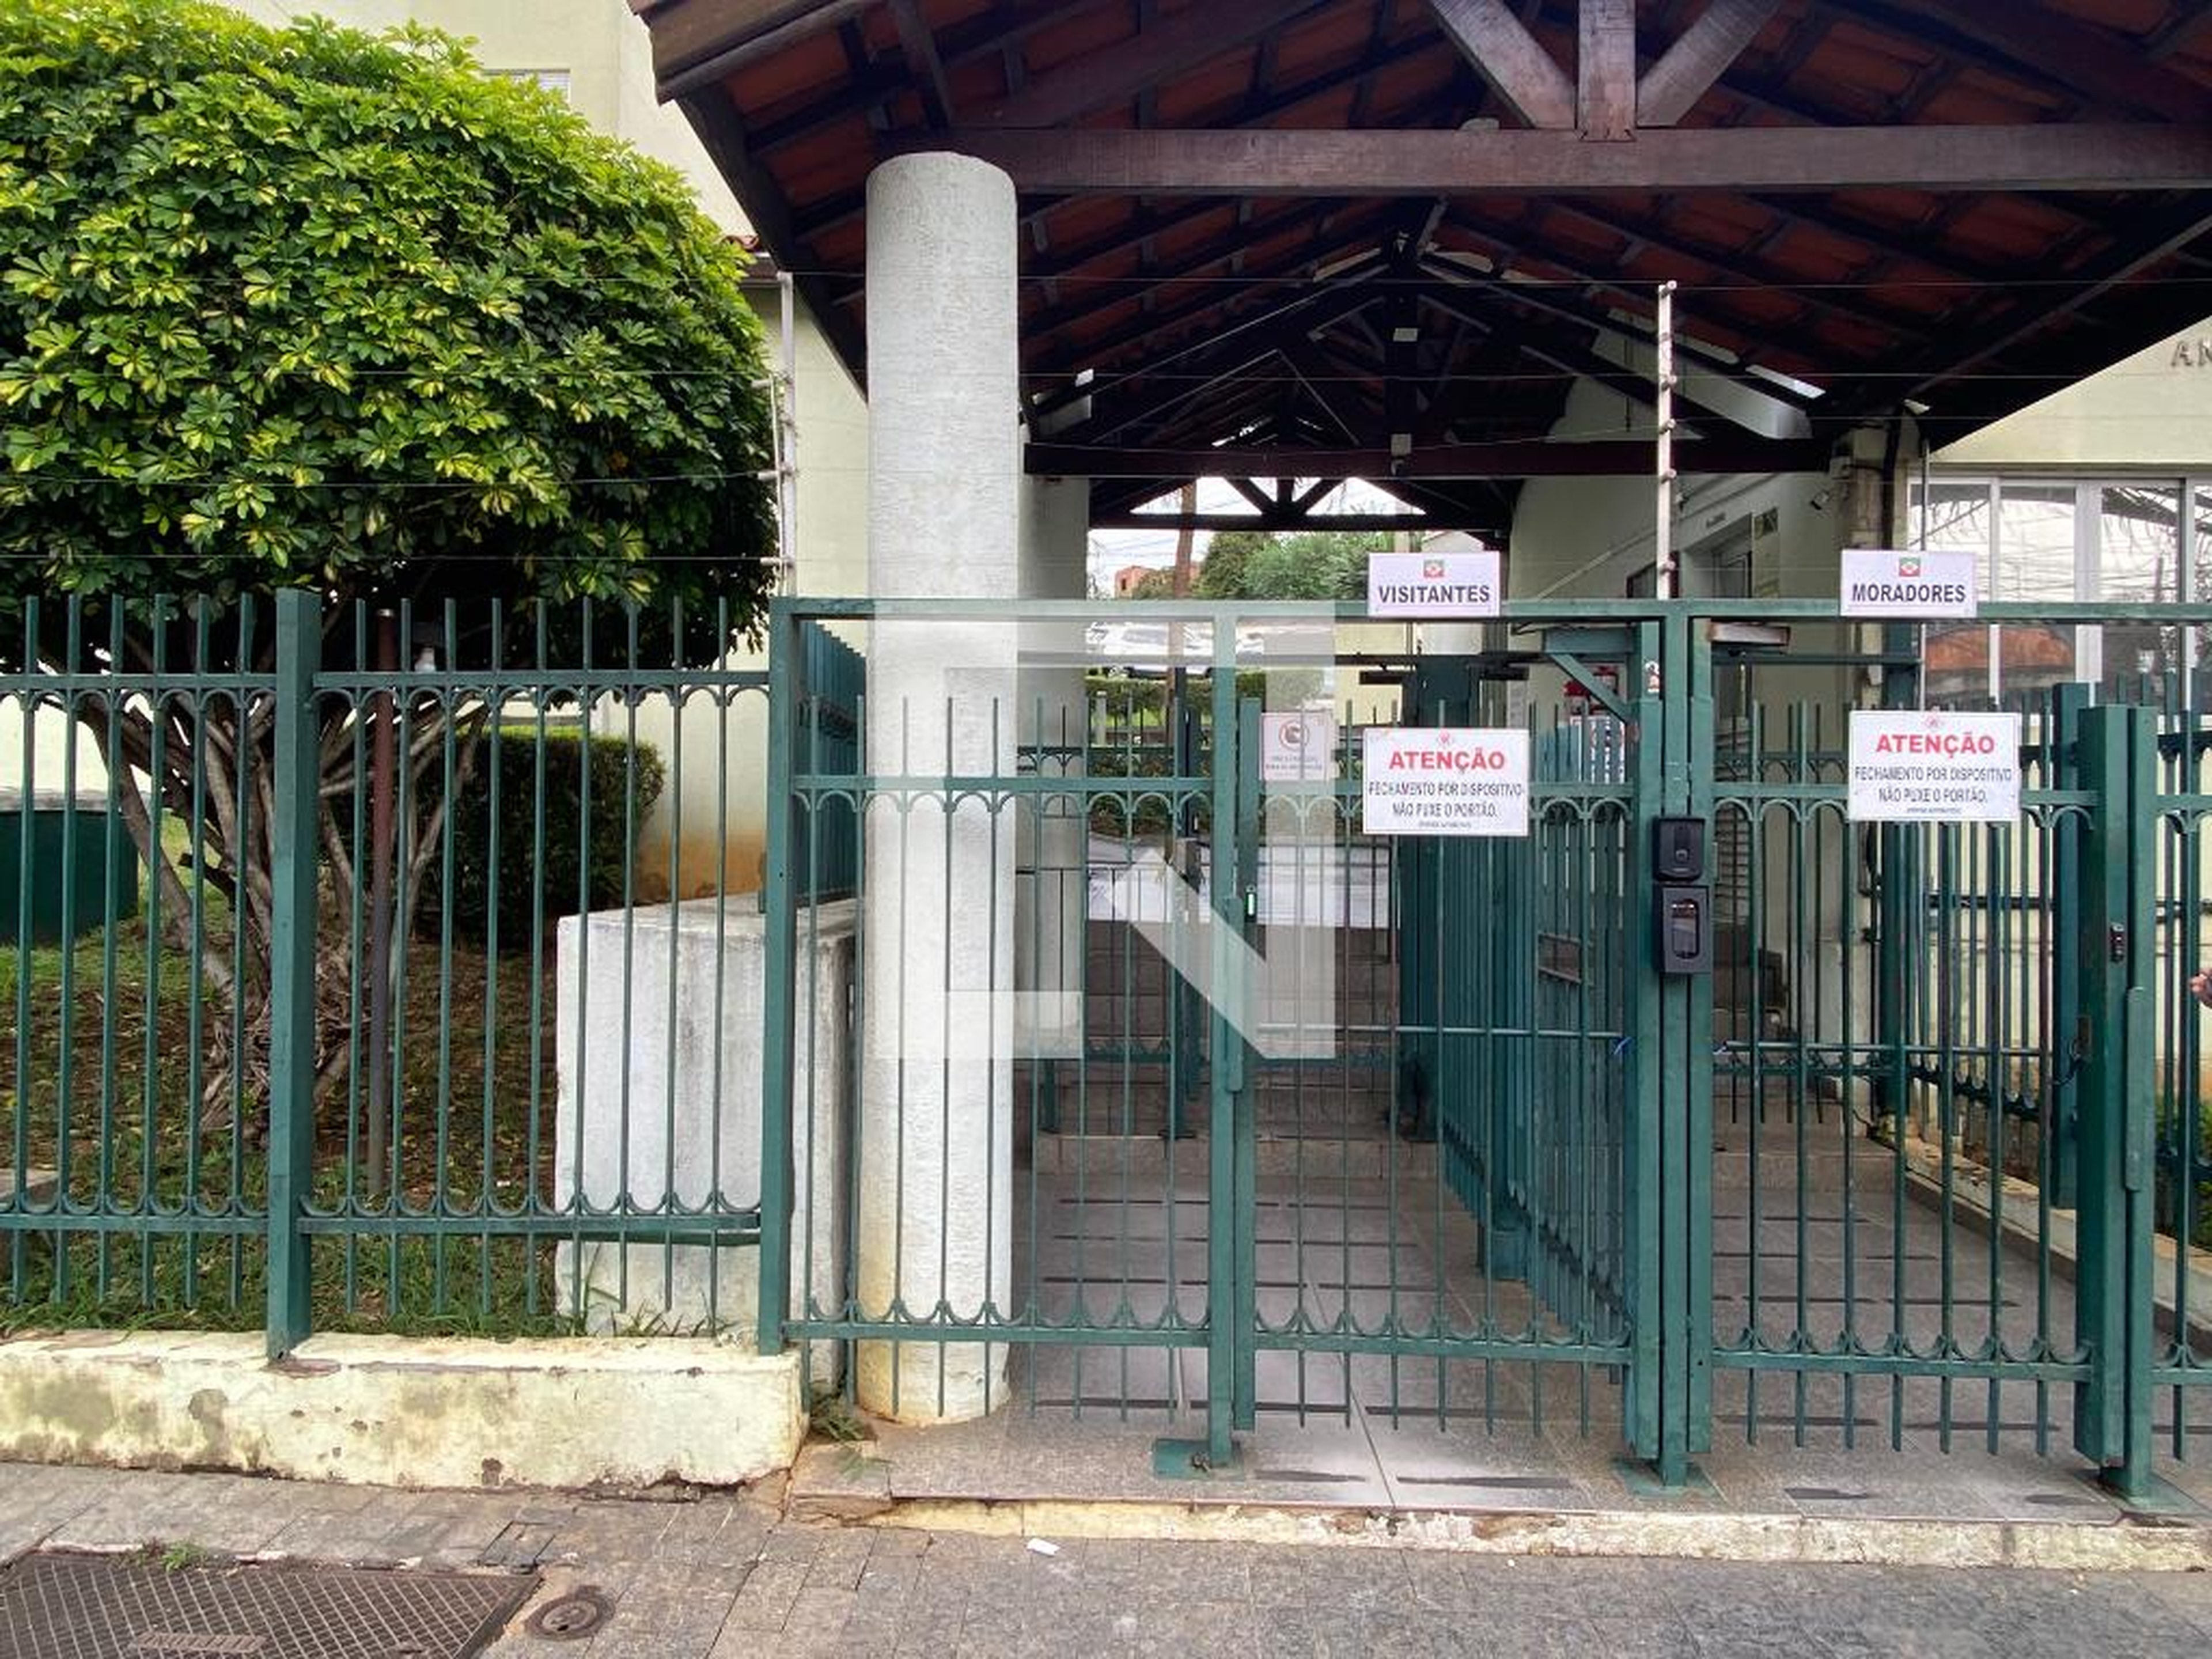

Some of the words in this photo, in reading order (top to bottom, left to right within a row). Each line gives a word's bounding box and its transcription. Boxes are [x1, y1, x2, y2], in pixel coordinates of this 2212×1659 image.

[1378, 584, 1490, 604] VISITANTES
[1851, 584, 1967, 603] MORADORES
[1876, 730, 1995, 759] ATENÇÃO
[1389, 747, 1506, 775] ATENÇÃO
[1855, 766, 1923, 781] FECHAMENTO
[1878, 786, 1902, 802] NÃO
